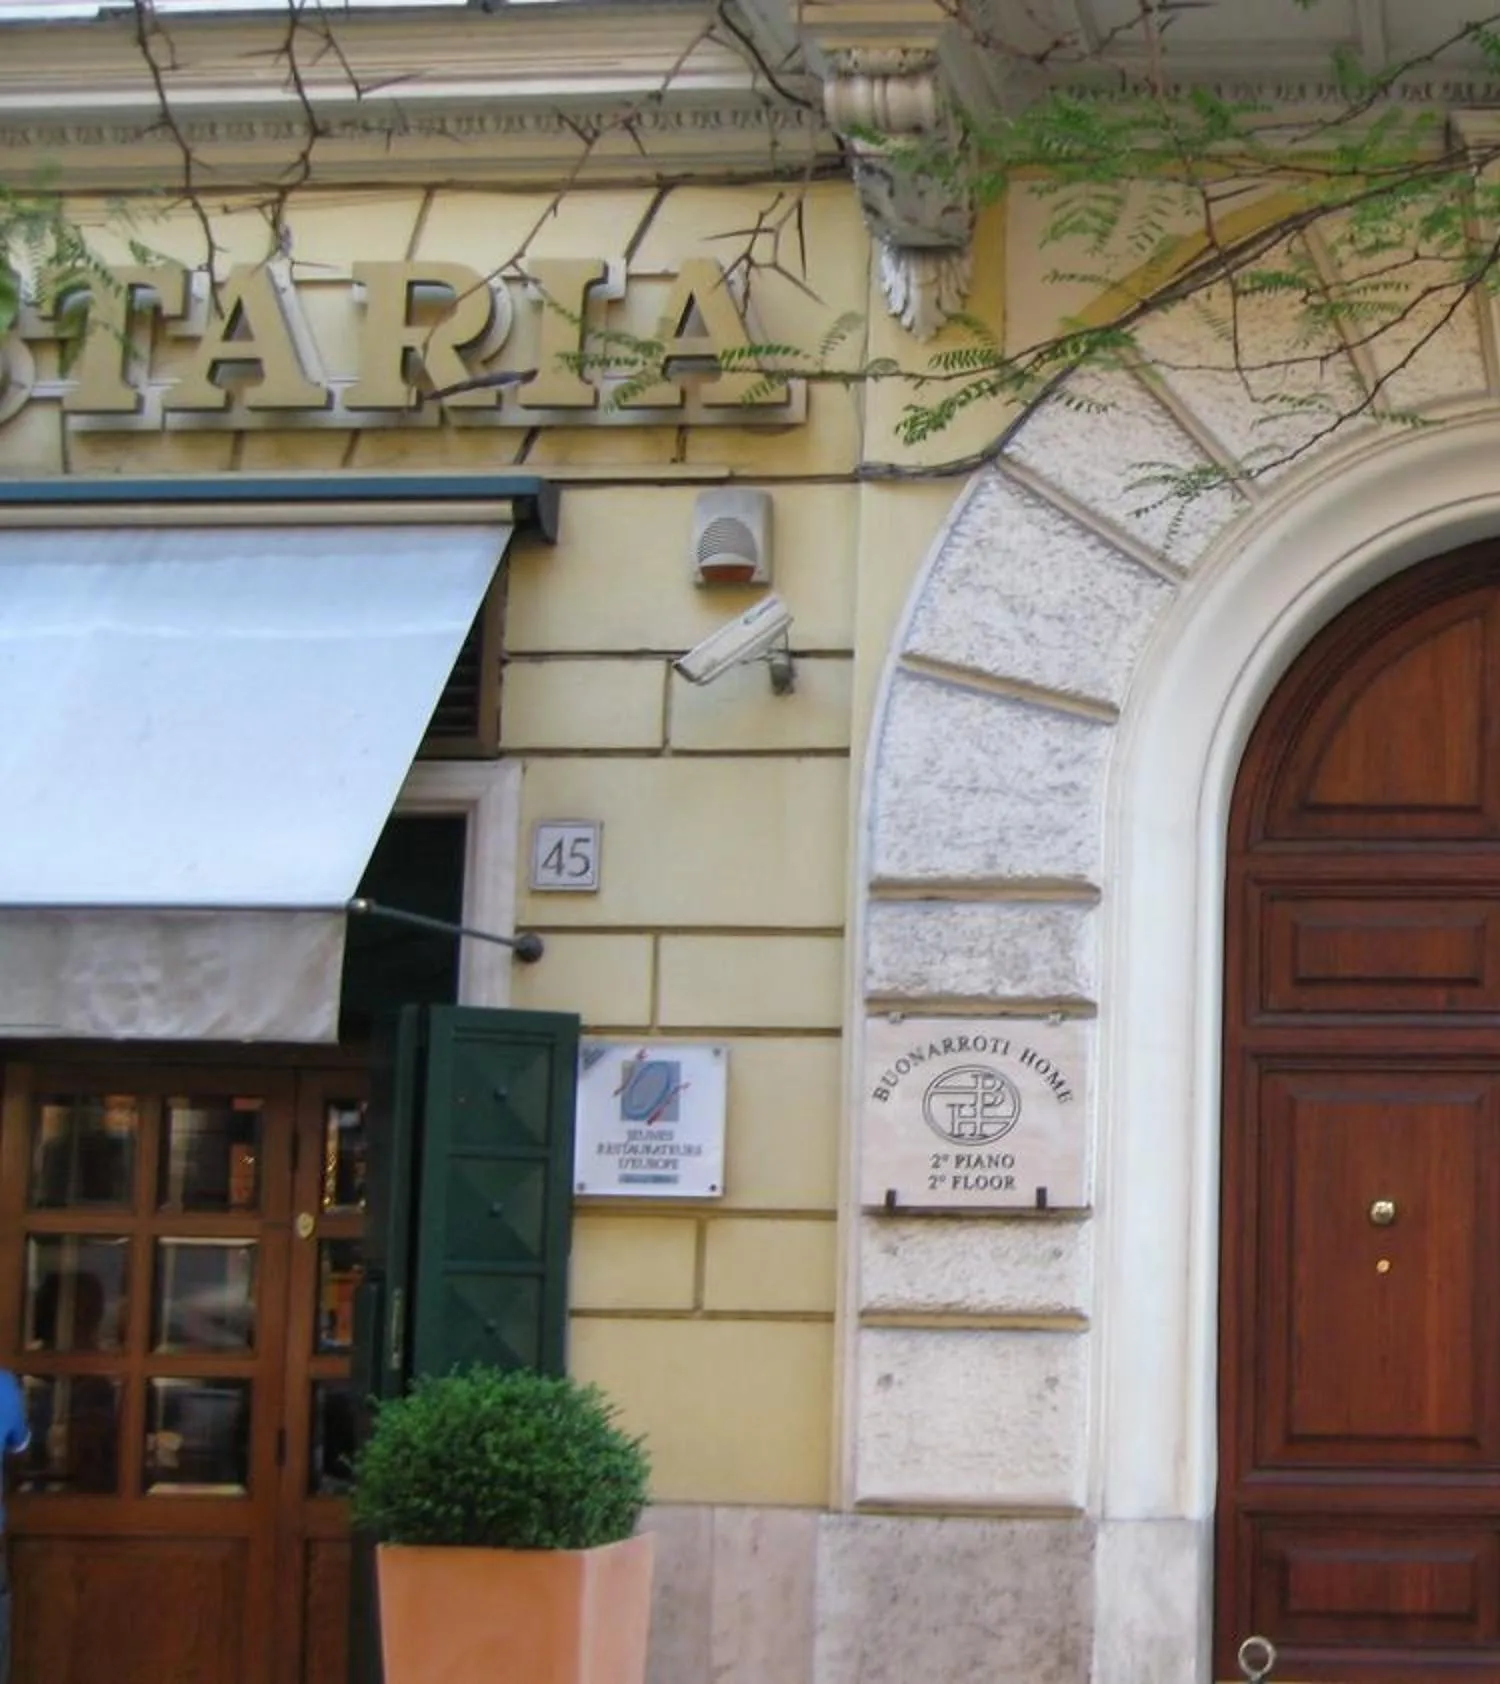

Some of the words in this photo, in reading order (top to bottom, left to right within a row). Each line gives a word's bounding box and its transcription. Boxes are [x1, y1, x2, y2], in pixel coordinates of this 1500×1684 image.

[0, 257, 792, 414] TARIA
[541, 836, 591, 878] 45
[872, 1035, 1011, 1104] BUONARROTI
[1019, 1047, 1074, 1104] HOME
[954, 1153, 1015, 1169] PIANO
[952, 1174, 1016, 1191] FLOOR
